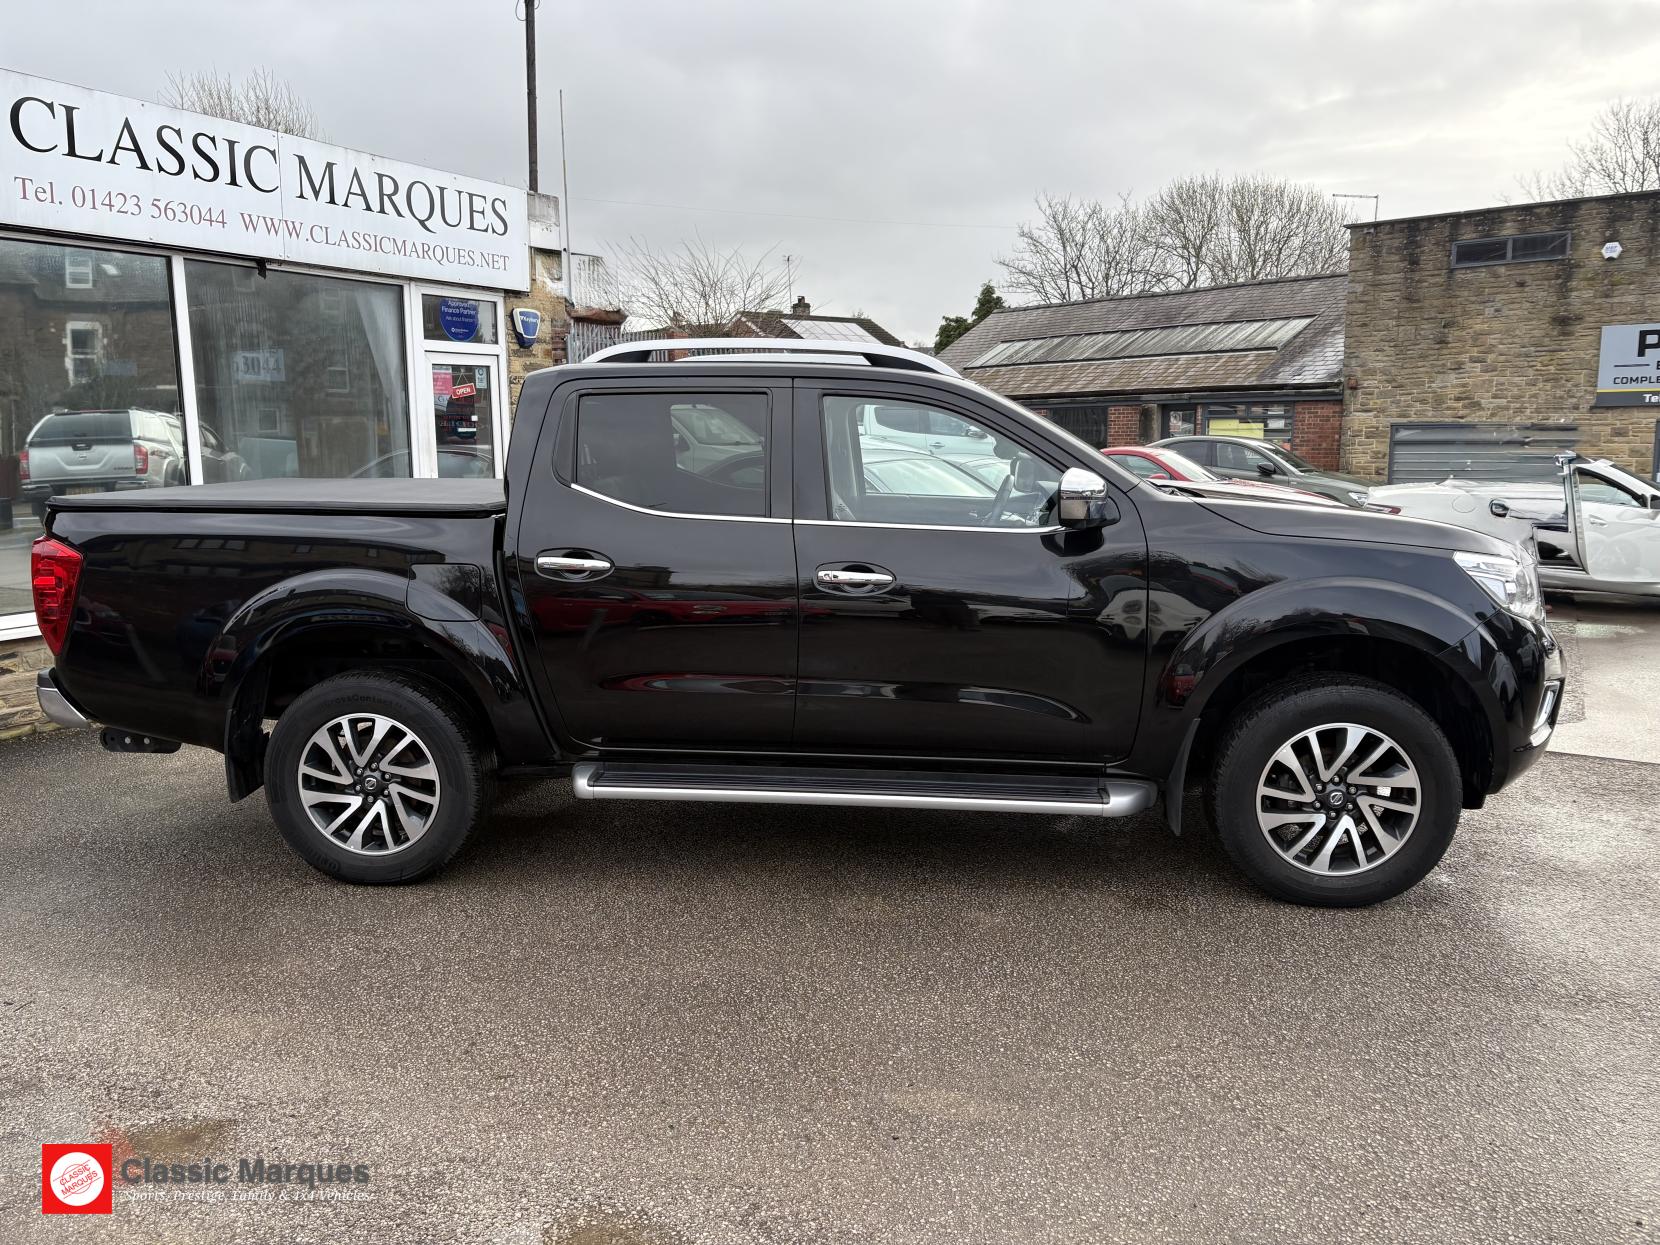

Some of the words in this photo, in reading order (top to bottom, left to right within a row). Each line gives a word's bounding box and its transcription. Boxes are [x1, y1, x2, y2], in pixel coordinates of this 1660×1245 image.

[9, 96, 279, 194] CLASSIC
[292, 154, 509, 236] MARQUES
[13, 176, 63, 206] Tel.
[71, 184, 143, 217] 01423
[150, 199, 228, 230] 563044
[239, 211, 510, 272] WWW.CLASSICMARQUES.NET
[455, 387, 471, 395] OPEN
